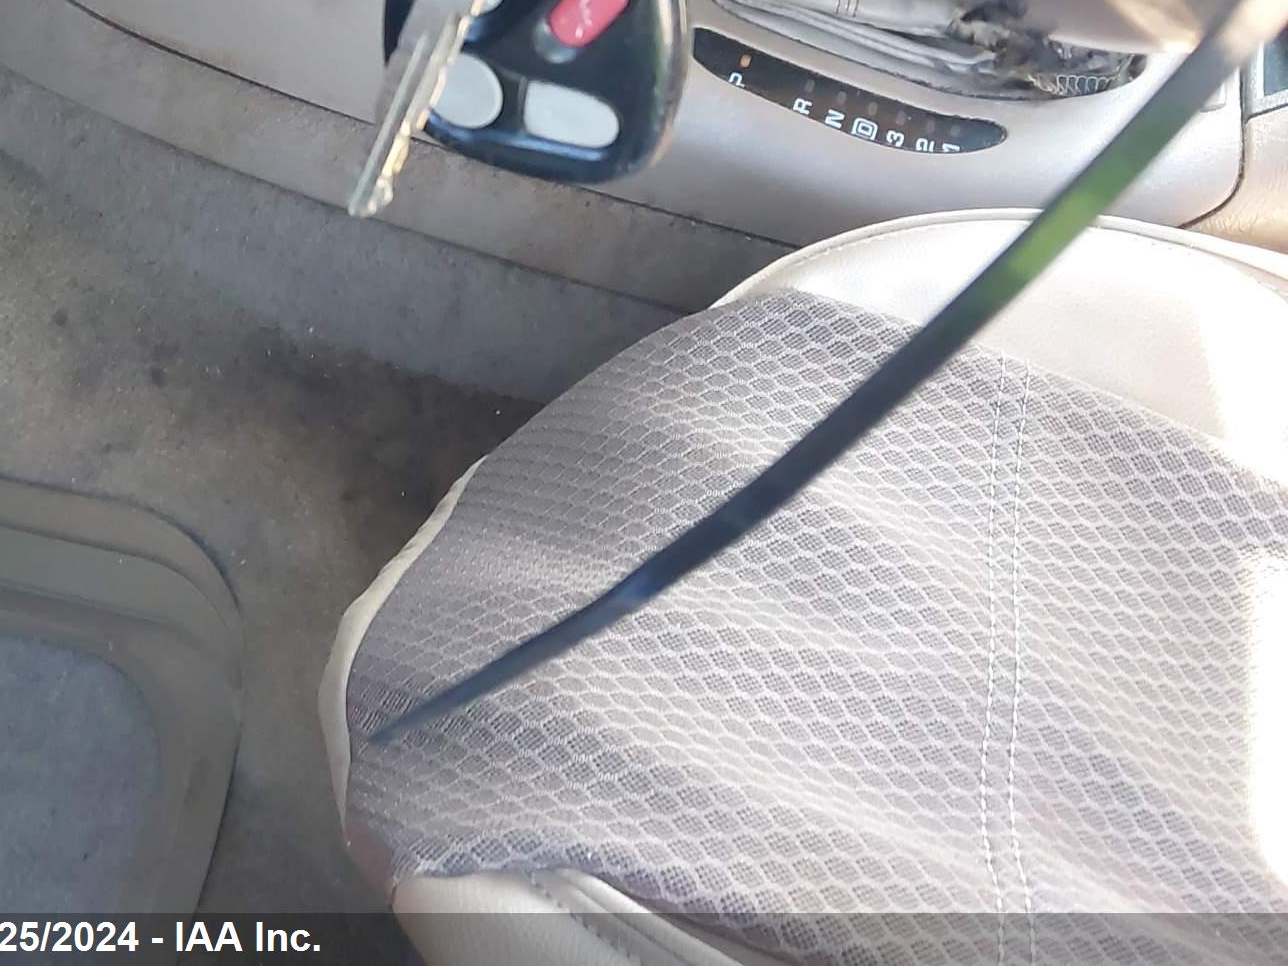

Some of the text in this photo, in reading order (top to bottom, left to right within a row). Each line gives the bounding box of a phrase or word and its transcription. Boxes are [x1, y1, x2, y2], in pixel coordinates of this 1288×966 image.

[793, 97, 813, 115] R
[824, 108, 845, 129] N
[886, 129, 905, 147] 3
